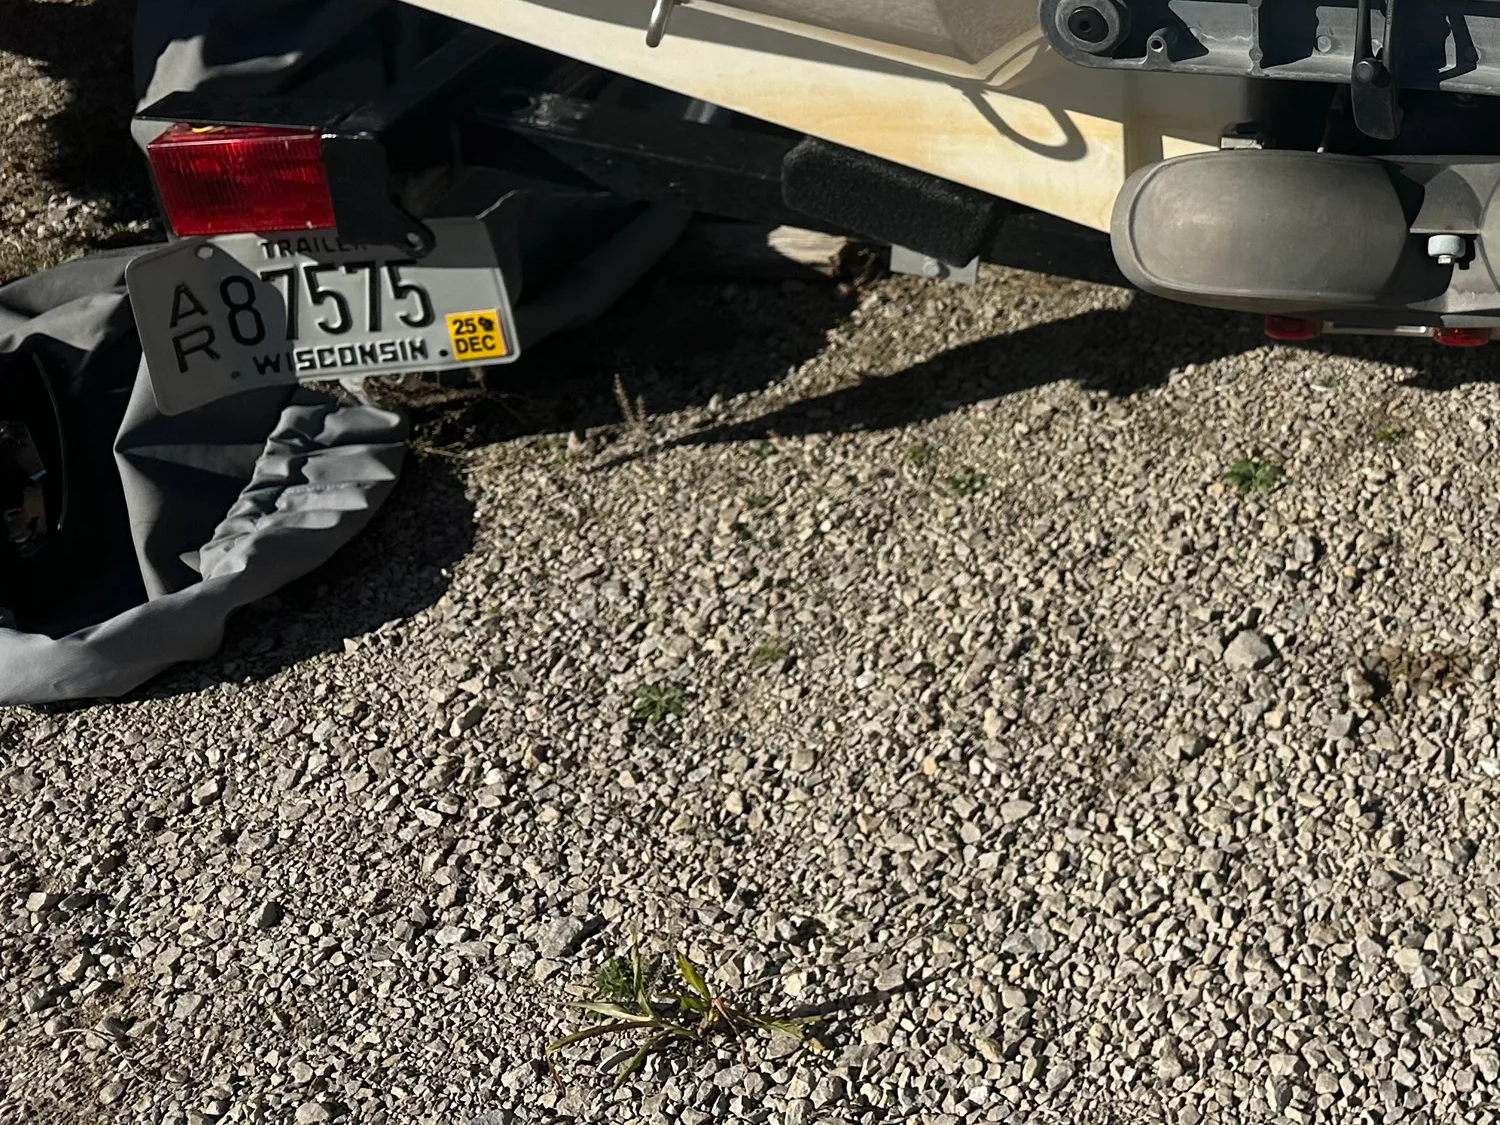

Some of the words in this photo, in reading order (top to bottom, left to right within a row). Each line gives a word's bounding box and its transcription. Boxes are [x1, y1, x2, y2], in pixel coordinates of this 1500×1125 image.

[219, 259, 436, 347] 87575
[452, 317, 477, 335] 25
[253, 339, 429, 376] WISCONSIN
[454, 335, 496, 354] DEC
